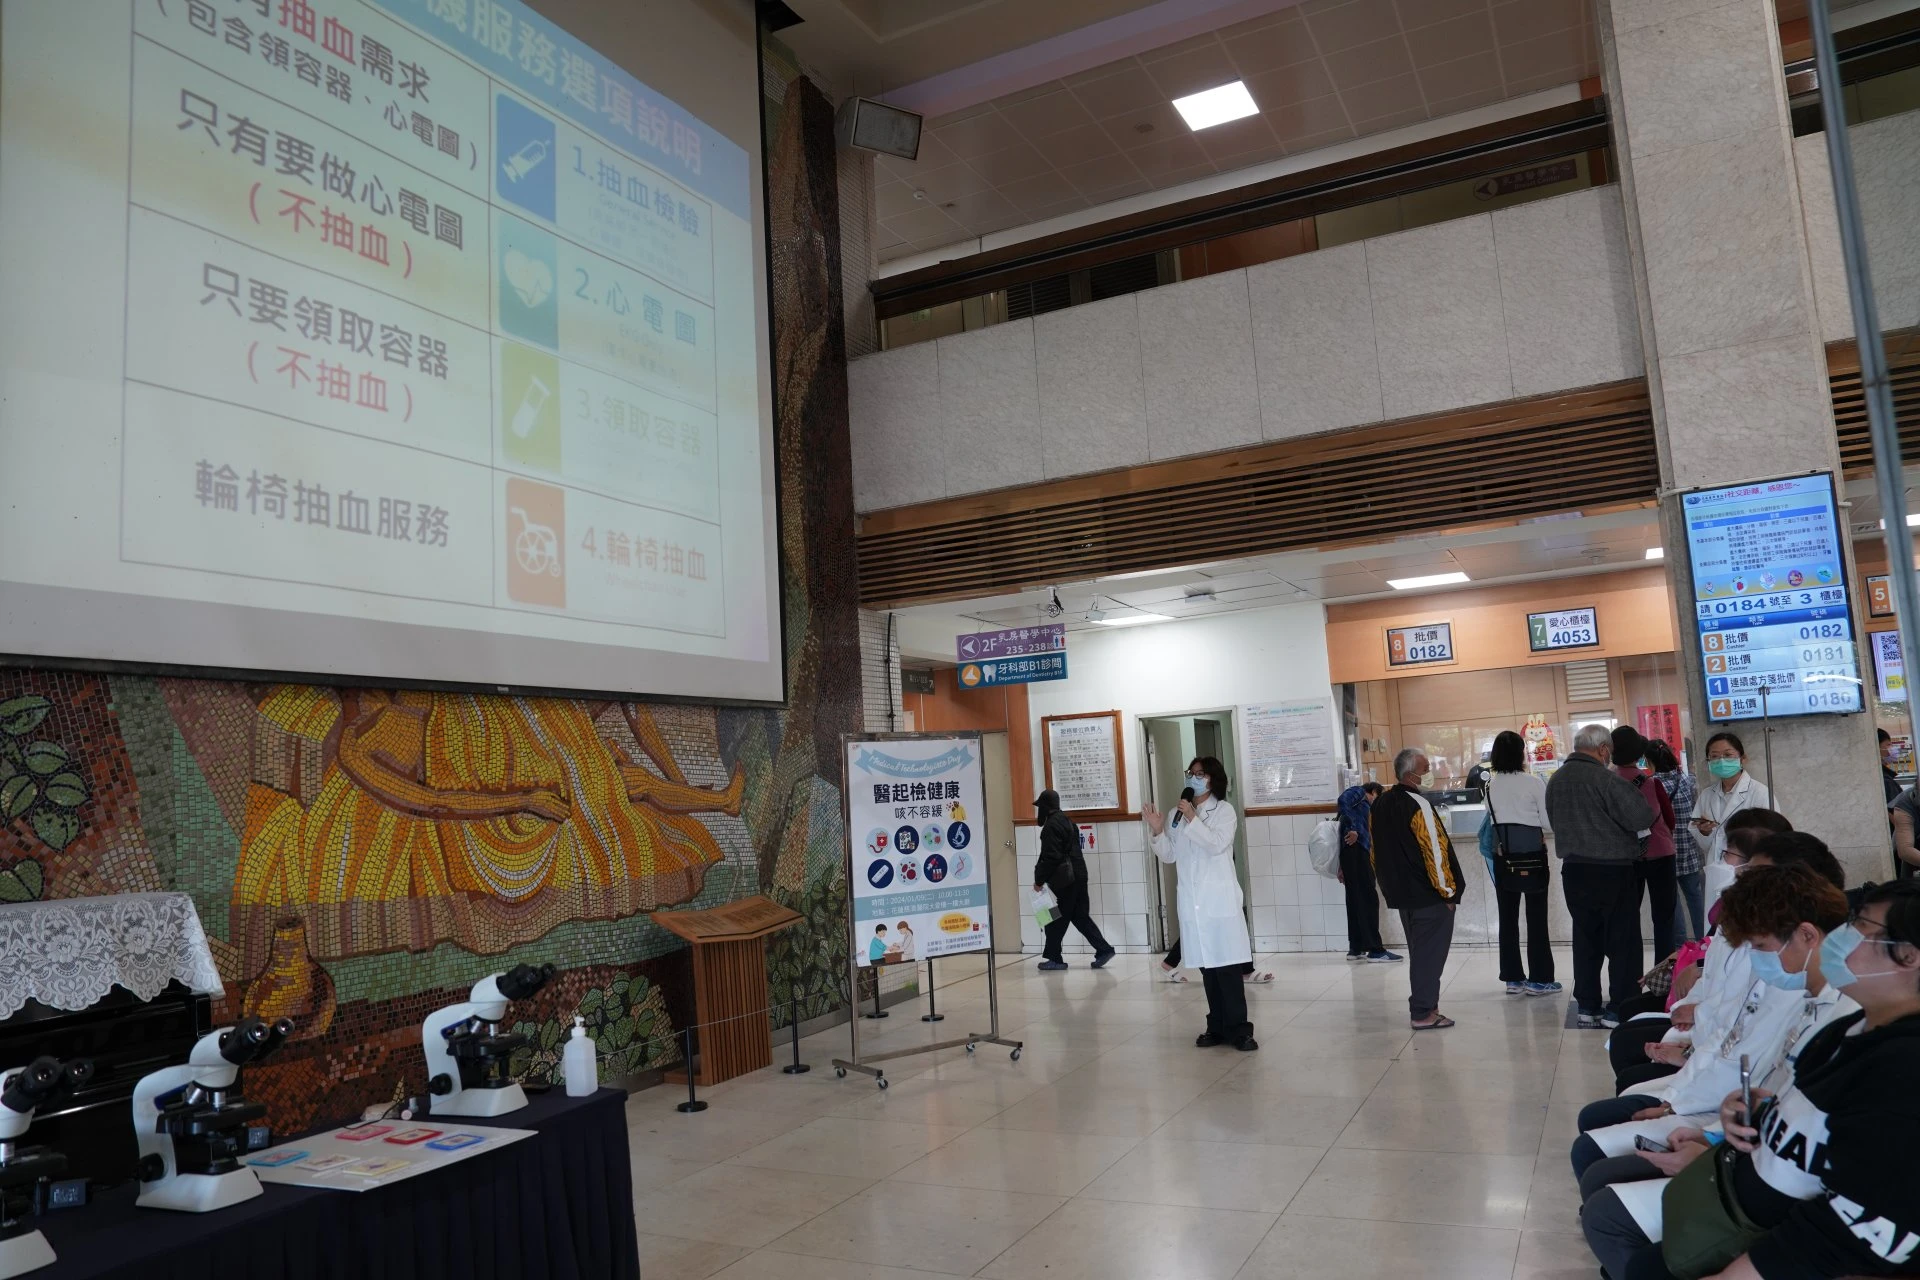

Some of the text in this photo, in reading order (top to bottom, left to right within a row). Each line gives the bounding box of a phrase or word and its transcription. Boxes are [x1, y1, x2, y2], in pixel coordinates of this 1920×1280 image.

[177, 88, 463, 250] 只有要做心電圖
[249, 182, 412, 279] (不抽血)
[200, 262, 449, 381] 只要領取容器
[247, 341, 413, 423] (不抽血)
[194, 459, 449, 548] 輪椅抽血服務
[581, 526, 708, 581] 4.輪椅抽血
[1715, 598, 1767, 614] 0184
[1769, 594, 1792, 607] 號至
[1800, 593, 1813, 605] 3
[1874, 588, 1886, 601] 5
[1414, 630, 1438, 642] 批價
[1534, 624, 1543, 637] 7
[1551, 629, 1591, 645] 4053
[1708, 624, 1843, 648] 8 批價 0182
[981, 638, 998, 652] 2F
[1393, 639, 1402, 651] 8
[1410, 644, 1447, 660] 0182
[998, 657, 1062, 675] 牙科部B1診間
[1710, 646, 1844, 671] 2 批價 0181
[1713, 680, 1722, 693] 1
[1716, 702, 1726, 715] 4
[1733, 698, 1757, 710] 批價
[873, 780, 961, 804] 醫起檢健康
[894, 804, 943, 820] 咳不容緩
